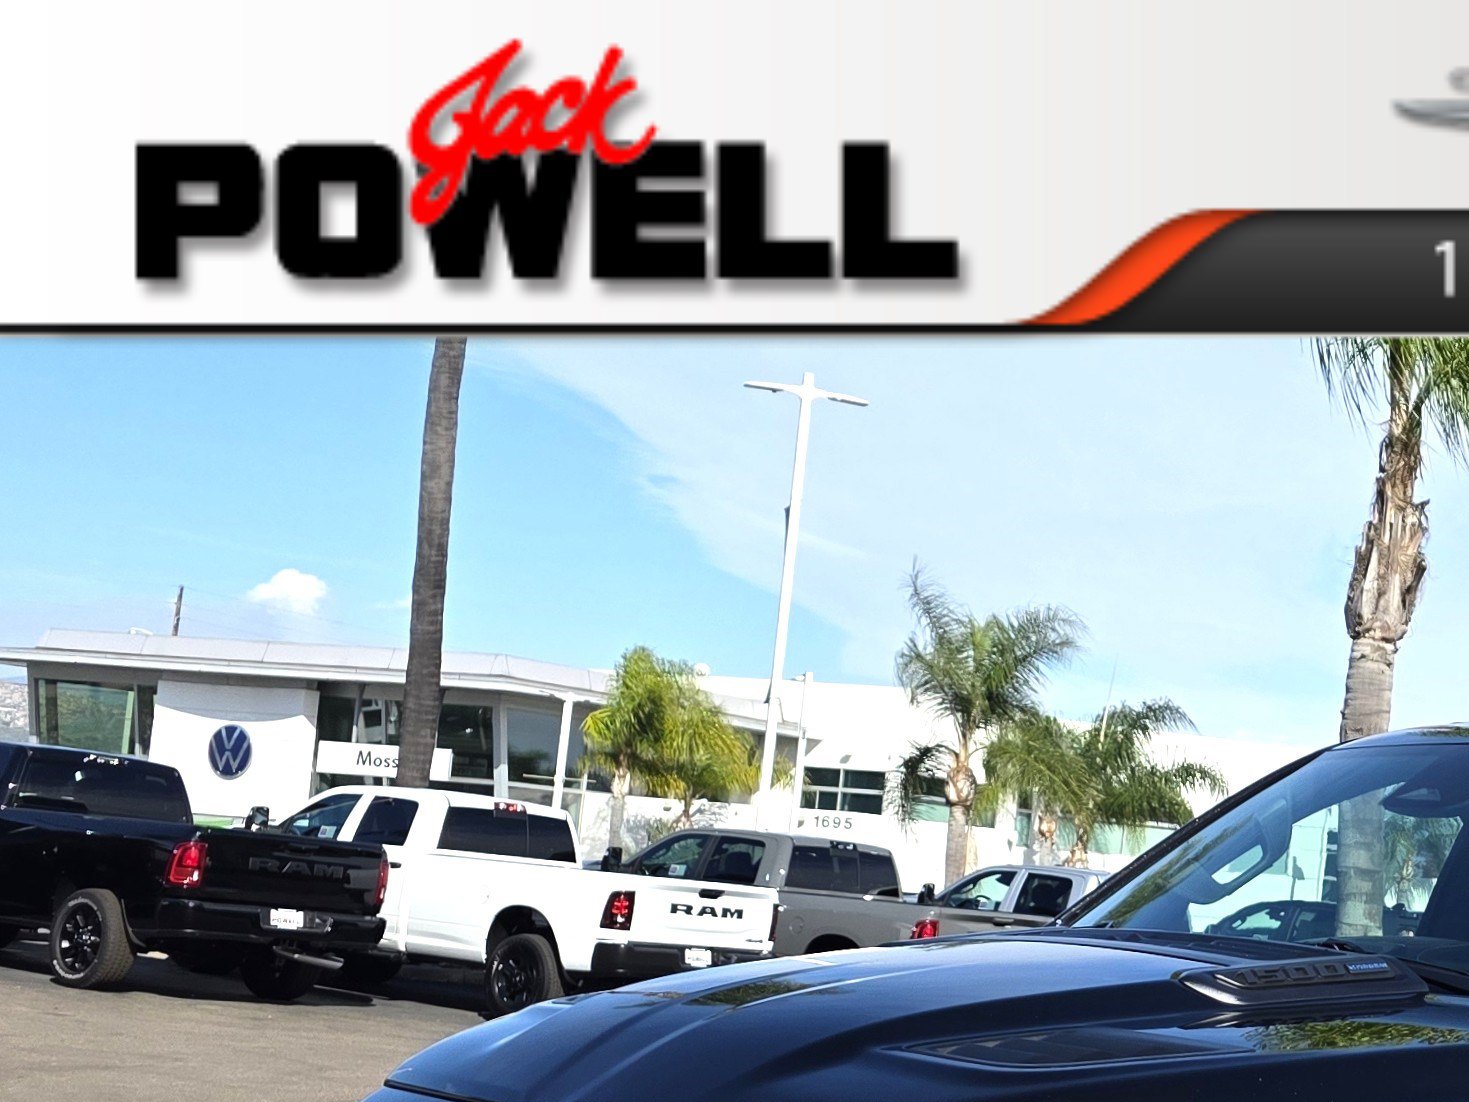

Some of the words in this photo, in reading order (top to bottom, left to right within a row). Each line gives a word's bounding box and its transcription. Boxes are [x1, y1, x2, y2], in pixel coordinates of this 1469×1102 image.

[813, 815, 853, 829] 1695
[248, 857, 344, 879] RAM
[670, 903, 744, 919] RAM
